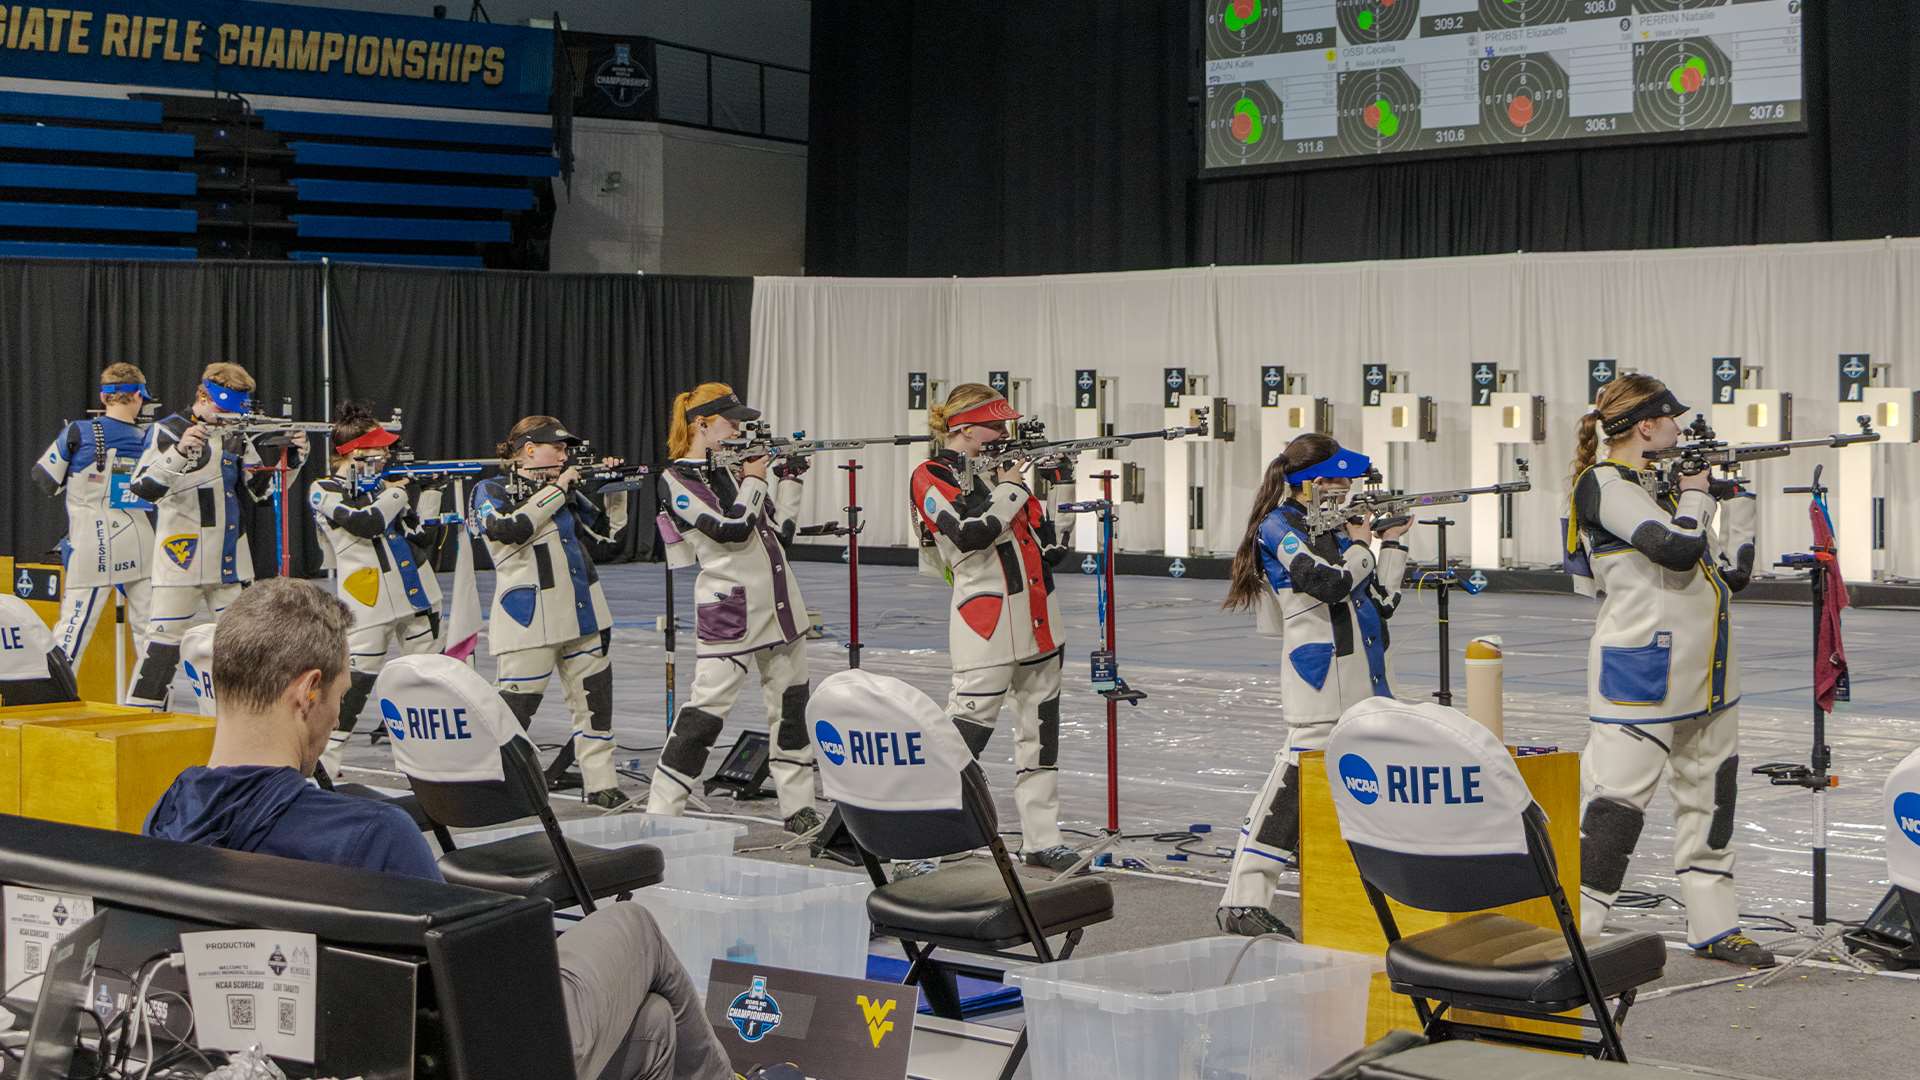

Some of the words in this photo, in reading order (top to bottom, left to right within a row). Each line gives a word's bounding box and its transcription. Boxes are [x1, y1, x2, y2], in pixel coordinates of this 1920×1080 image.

[1434, 16, 1464, 31] 309.2
[1640, 14, 1679, 26] PERRIN
[1296, 32, 1323, 45] 309.8
[1485, 30, 1524, 41] PROBST
[0, 3, 93, 54] IATE
[101, 13, 203, 63] RIFLE
[218, 23, 505, 86] CHAMPIONSHIPS
[1636, 44, 1644, 56] H
[1342, 47, 1364, 58] OSSI
[1210, 60, 1233, 72] ZAUN
[1481, 60, 1489, 71] G
[1340, 74, 1346, 84] F
[1208, 86, 1214, 98] E
[1750, 104, 1784, 120] 307.6
[1584, 118, 1616, 132] 306.1
[1436, 129, 1465, 142] 310.6
[1296, 141, 1324, 154] 311.8
[1170, 390, 1179, 405] 4
[1268, 390, 1278, 406] 5
[1370, 389, 1380, 404] 6
[1480, 389, 1490, 404] 7
[1720, 386, 1732, 402] 9
[1847, 382, 1859, 400] A
[914, 394, 920, 408] 1
[1080, 393, 1090, 408] 3
[96, 520, 106, 572] PEISER
[114, 560, 136, 572] USA
[48, 574, 58, 596] 9
[406, 706, 472, 740] RIFLE
[820, 740, 845, 756] NCAA
[848, 730, 926, 766] RIFLE
[1345, 776, 1378, 794] NCAA
[1386, 764, 1484, 804] RIFLE
[206, 942, 256, 950] PRODUCTION
[216, 982, 232, 990] NCAA
[233, 980, 264, 990] SCORECARD
[728, 1008, 780, 1024] CHAMPIONSHIPS
